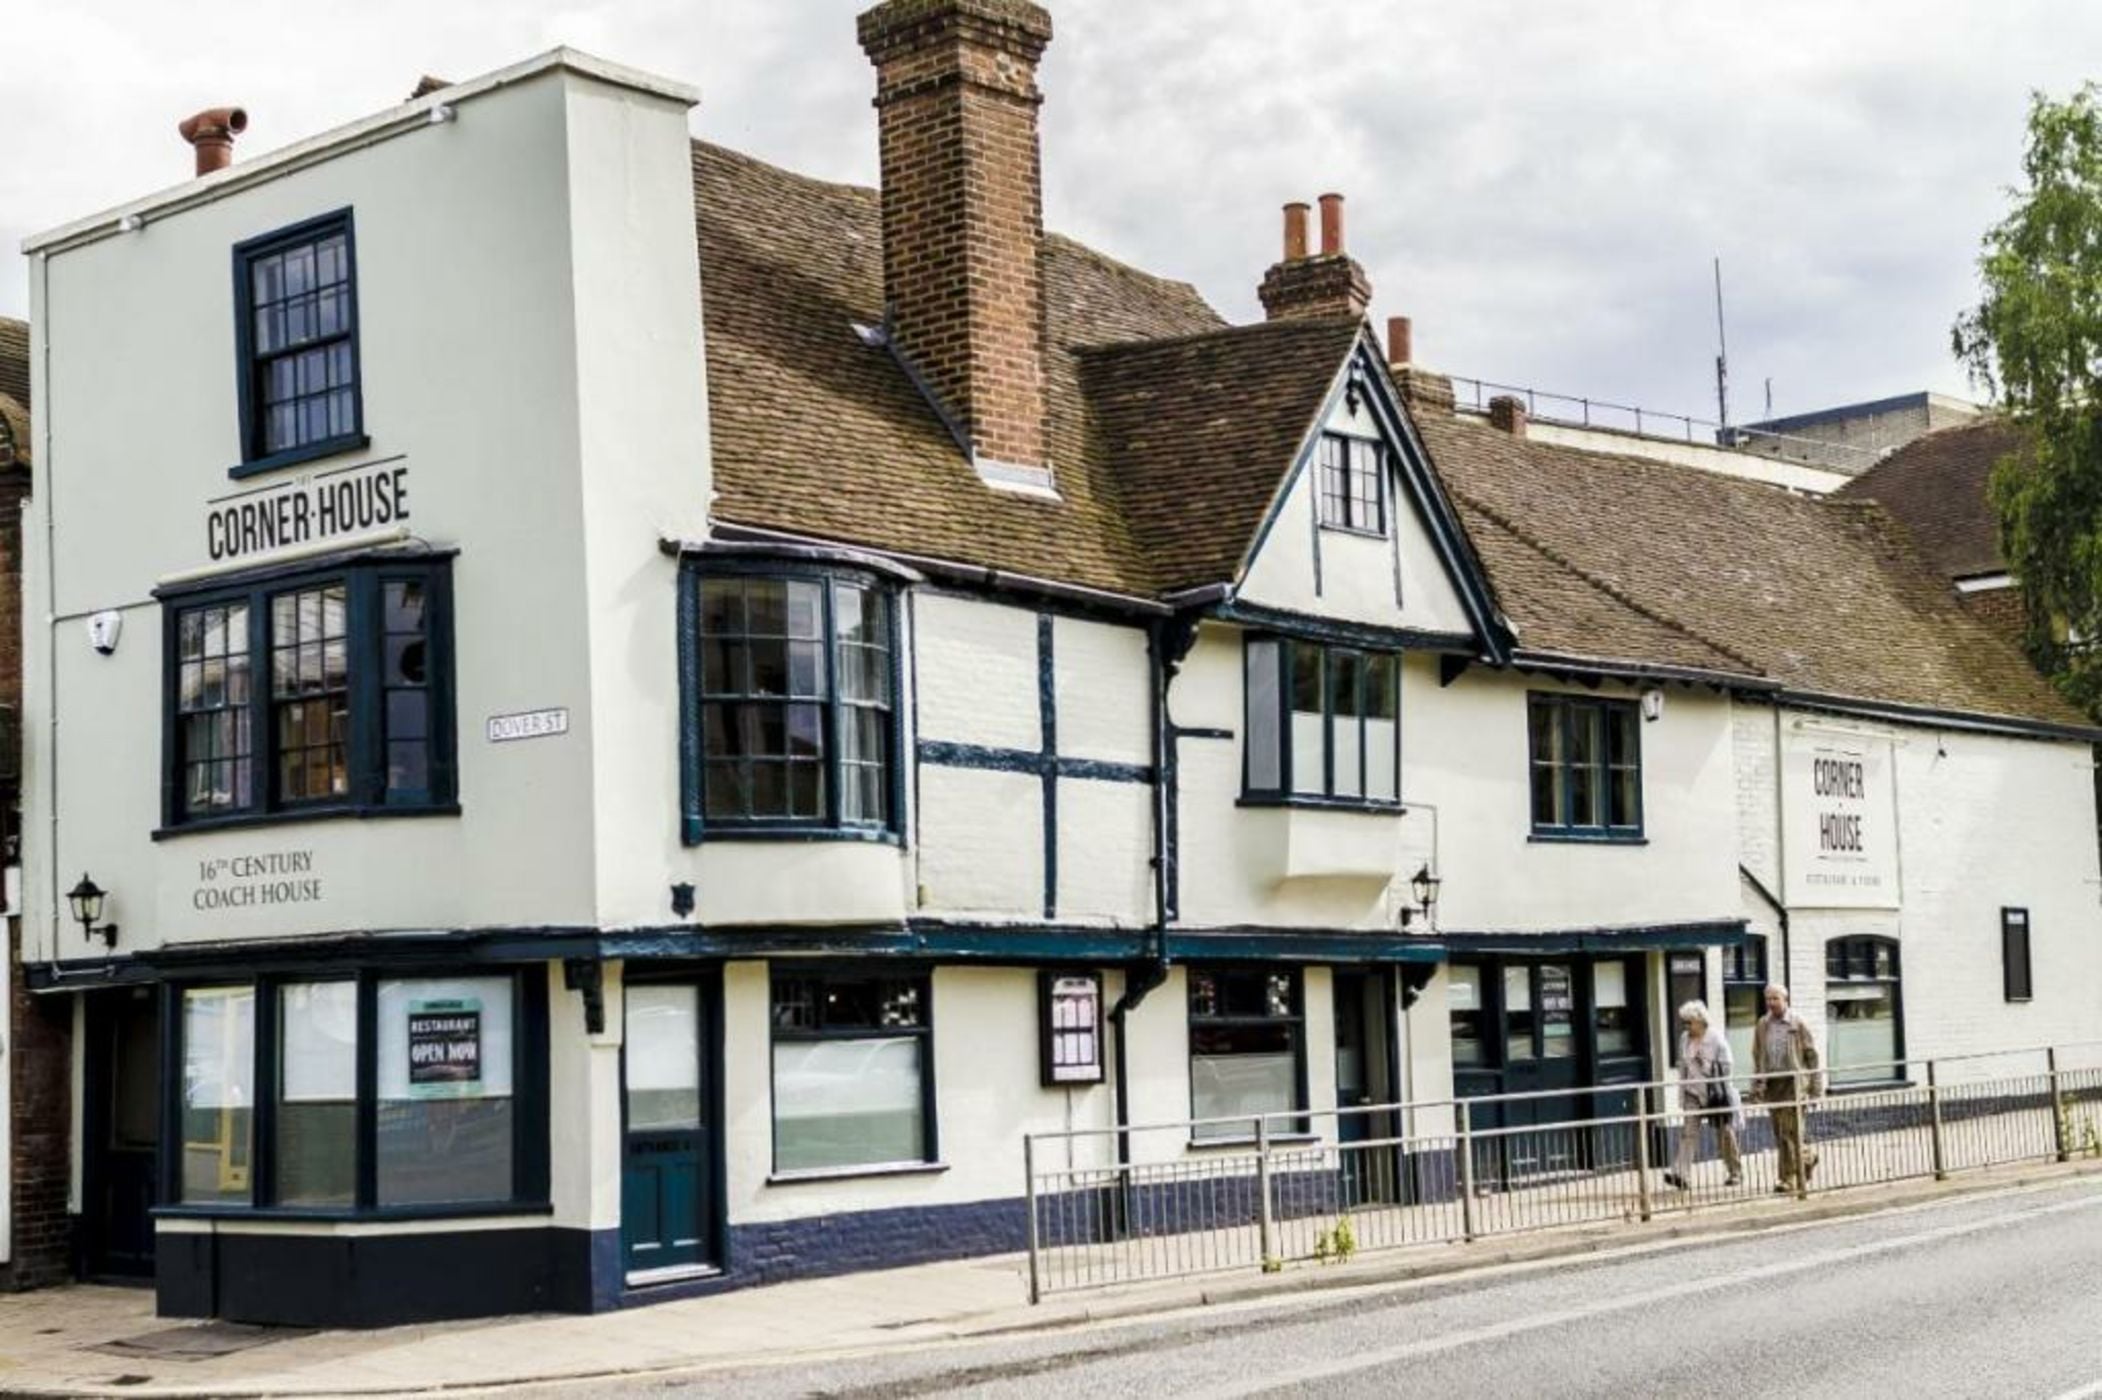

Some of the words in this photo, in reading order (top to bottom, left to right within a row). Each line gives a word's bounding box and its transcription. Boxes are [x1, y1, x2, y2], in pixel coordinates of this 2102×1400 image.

[207, 492, 310, 560] CORNER
[318, 468, 410, 537] HOUSE
[493, 715, 542, 737] DOVER
[545, 713, 561, 732] ST
[1814, 758, 1864, 799] CORNER
[1820, 813, 1863, 851] HOUSE
[231, 850, 312, 877] CENTURY
[193, 886, 255, 910] COACH
[261, 879, 322, 904] HOUSE
[411, 1018, 476, 1033] RESTAURANT
[411, 1042, 445, 1063] OPEN
[448, 1040, 477, 1061] NOW
